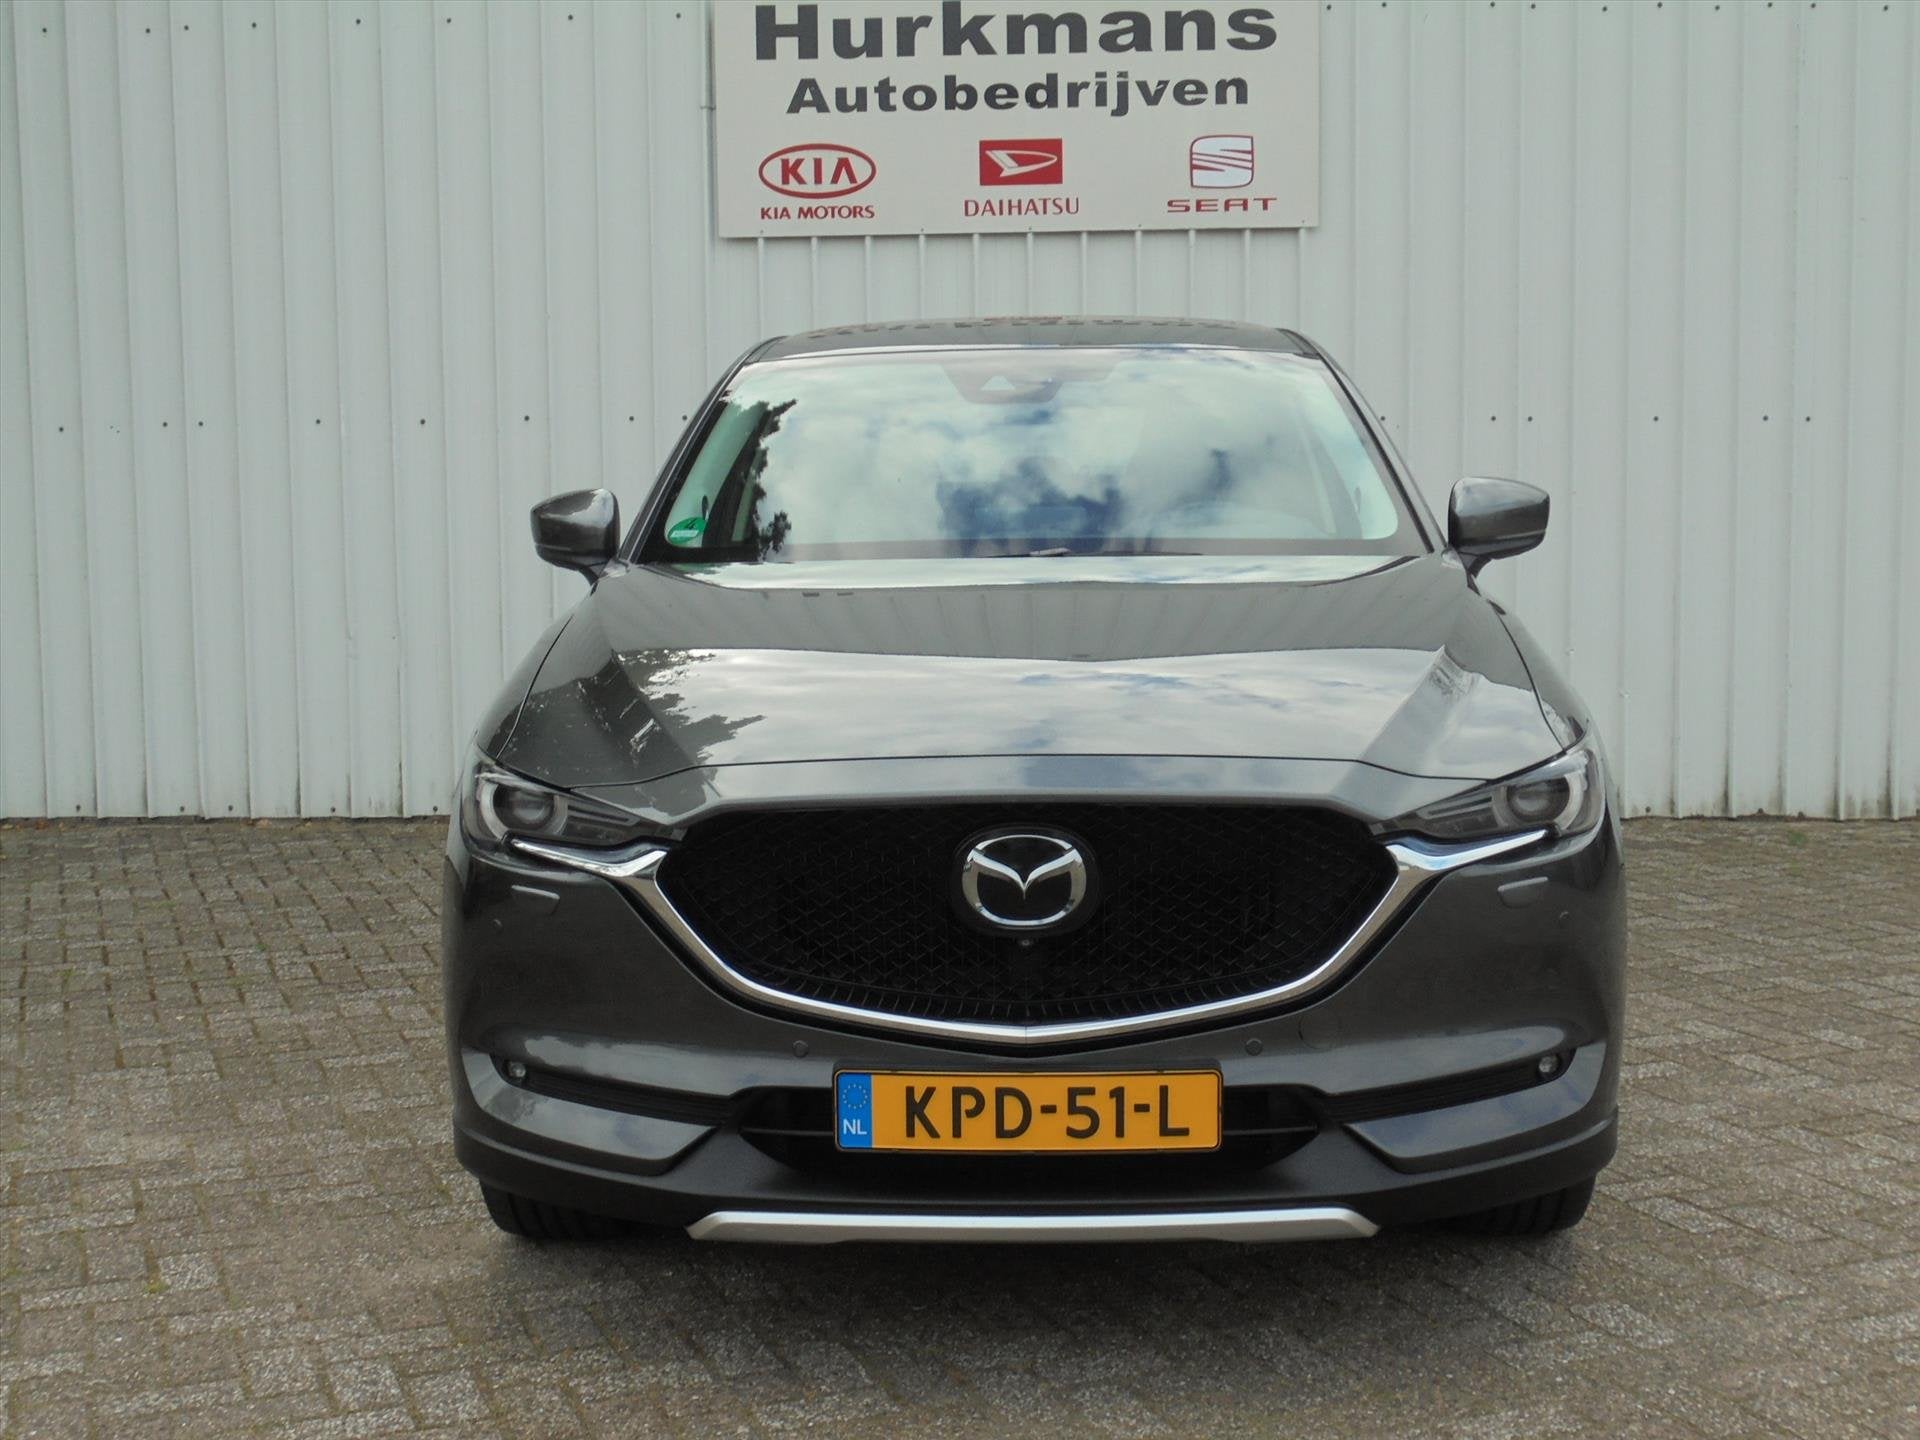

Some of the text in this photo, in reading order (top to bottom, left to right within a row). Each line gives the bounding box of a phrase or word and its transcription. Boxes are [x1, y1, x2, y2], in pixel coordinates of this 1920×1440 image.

[755, 0, 1277, 61] Hurkmans
[786, 71, 1249, 117] Autobedrijven
[780, 157, 858, 185] KIA
[760, 205, 875, 220] KIA MOTORS
[964, 197, 1080, 217] DAIHATSU
[1166, 197, 1277, 213] SEAT
[904, 1085, 1190, 1139] KPD-51-L
[842, 1119, 867, 1135] NL
